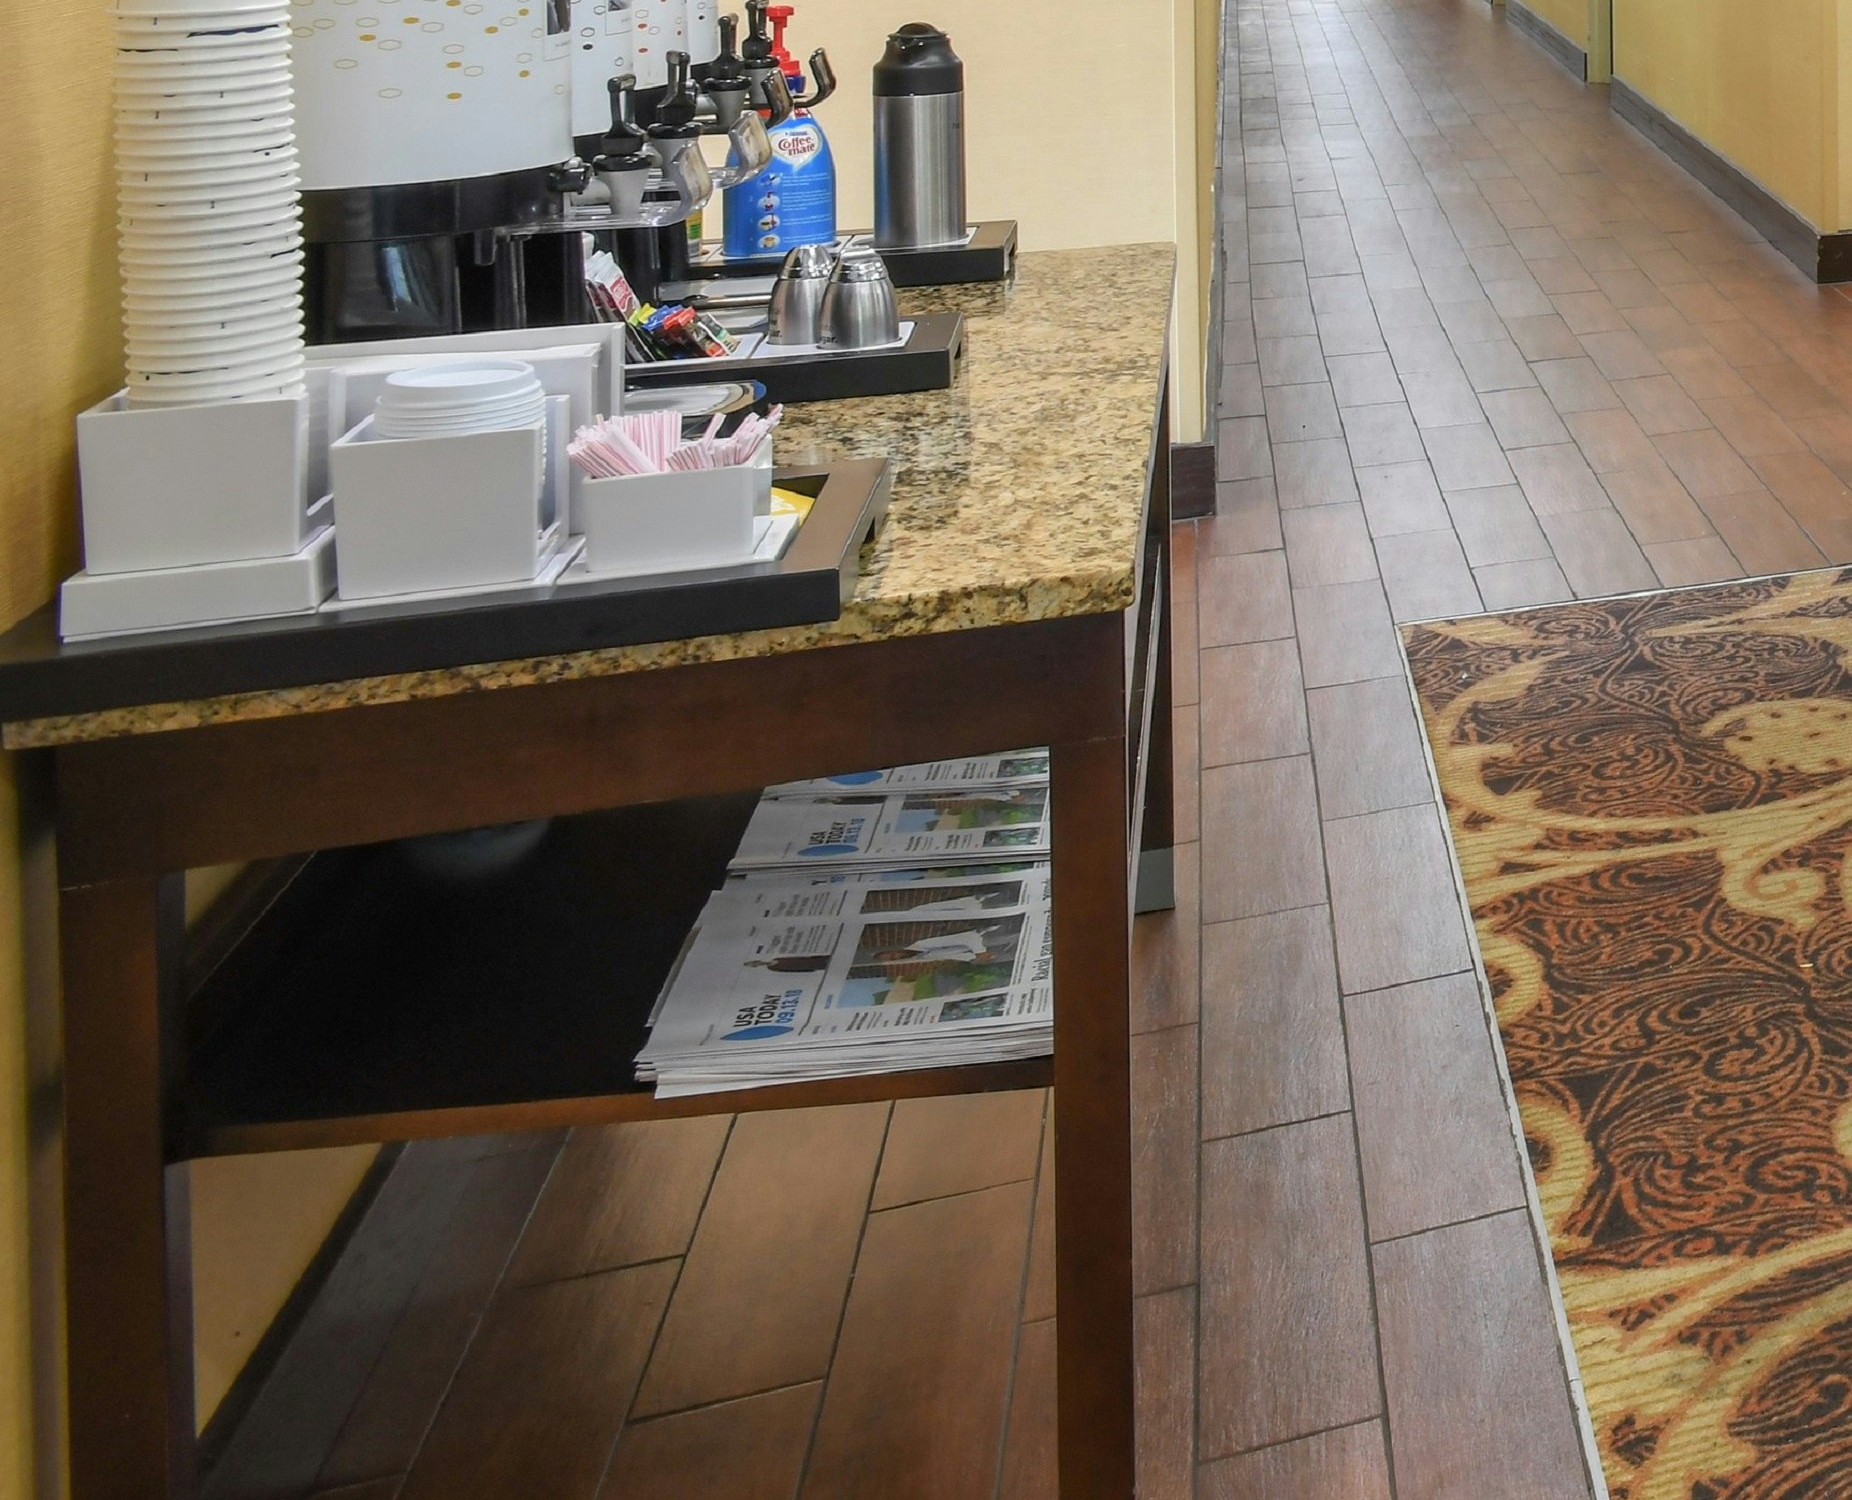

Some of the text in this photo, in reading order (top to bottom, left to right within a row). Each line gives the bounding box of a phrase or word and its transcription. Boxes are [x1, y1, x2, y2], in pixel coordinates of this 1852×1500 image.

[788, 143, 816, 156] mate
[807, 830, 828, 846] USA
[825, 821, 848, 845] TODAY
[1031, 958, 1051, 982] Racial
[733, 1005, 758, 1028] USA
[754, 994, 782, 1026] TODAY
[775, 989, 803, 1024] 09.13.18
